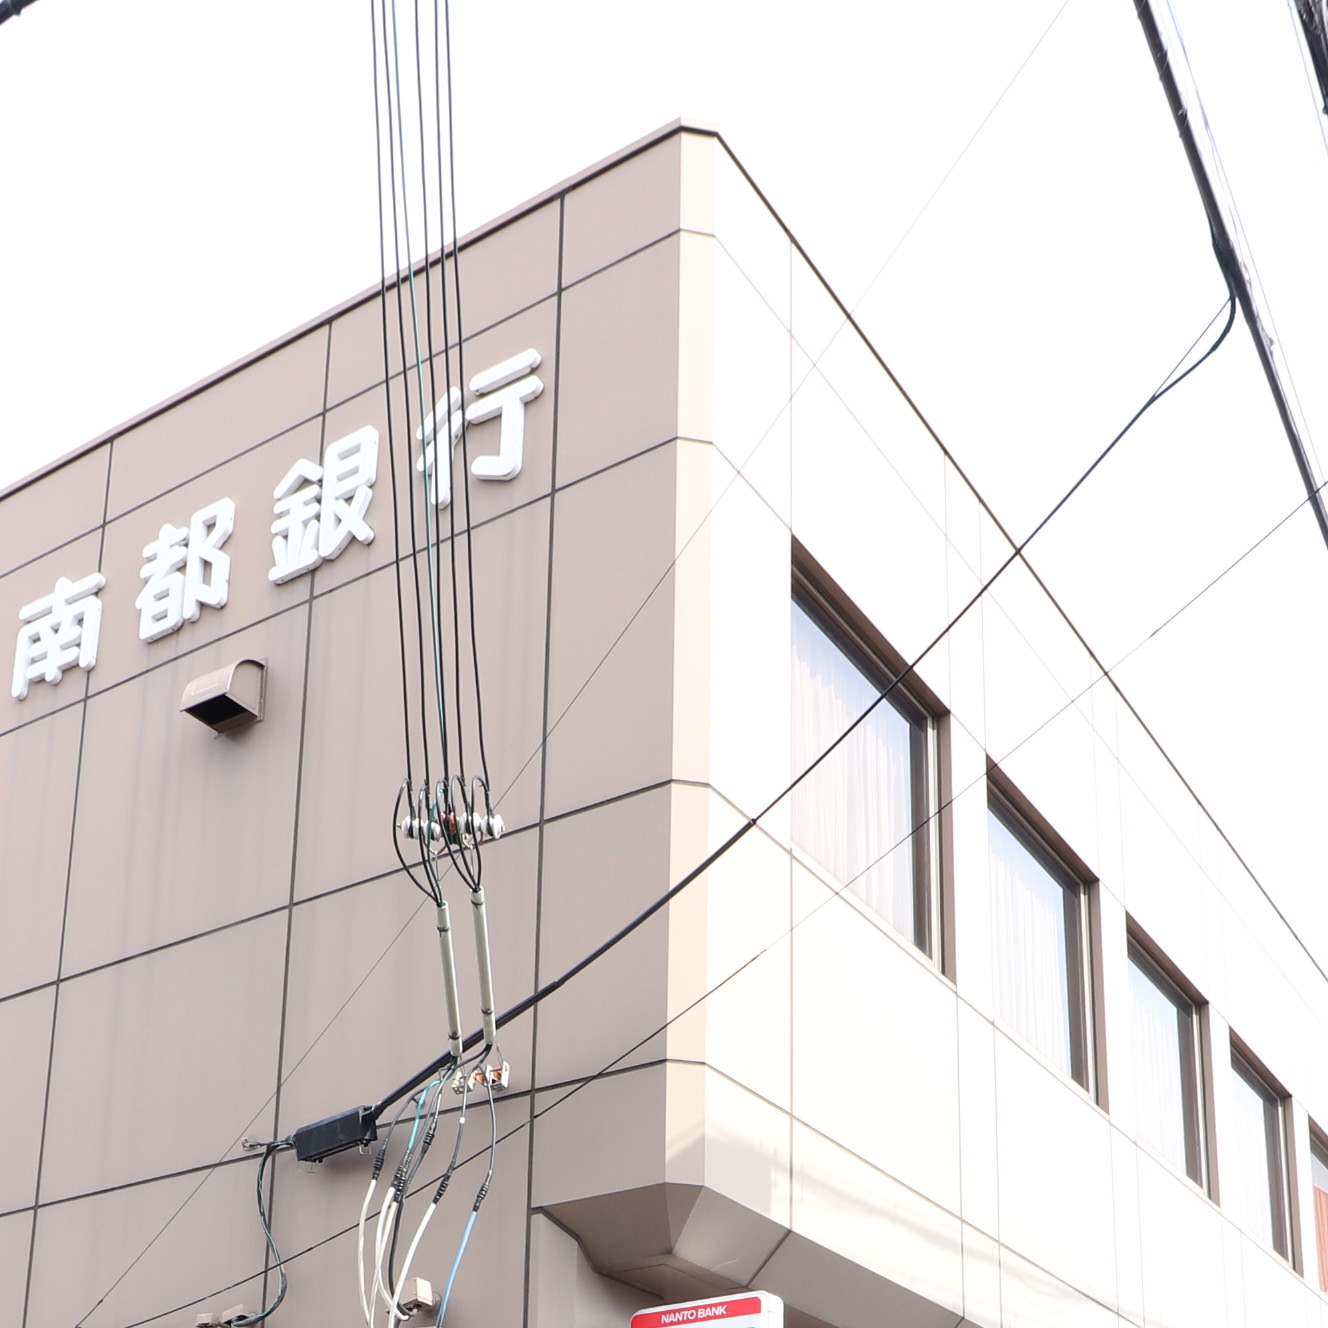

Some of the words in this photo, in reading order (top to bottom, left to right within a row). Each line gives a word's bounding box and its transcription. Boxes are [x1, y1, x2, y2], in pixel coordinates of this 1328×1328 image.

[12, 348, 544, 700] 南都銀行
[661, 1309, 696, 1324] NANTO
[697, 1304, 728, 1319] BANK
